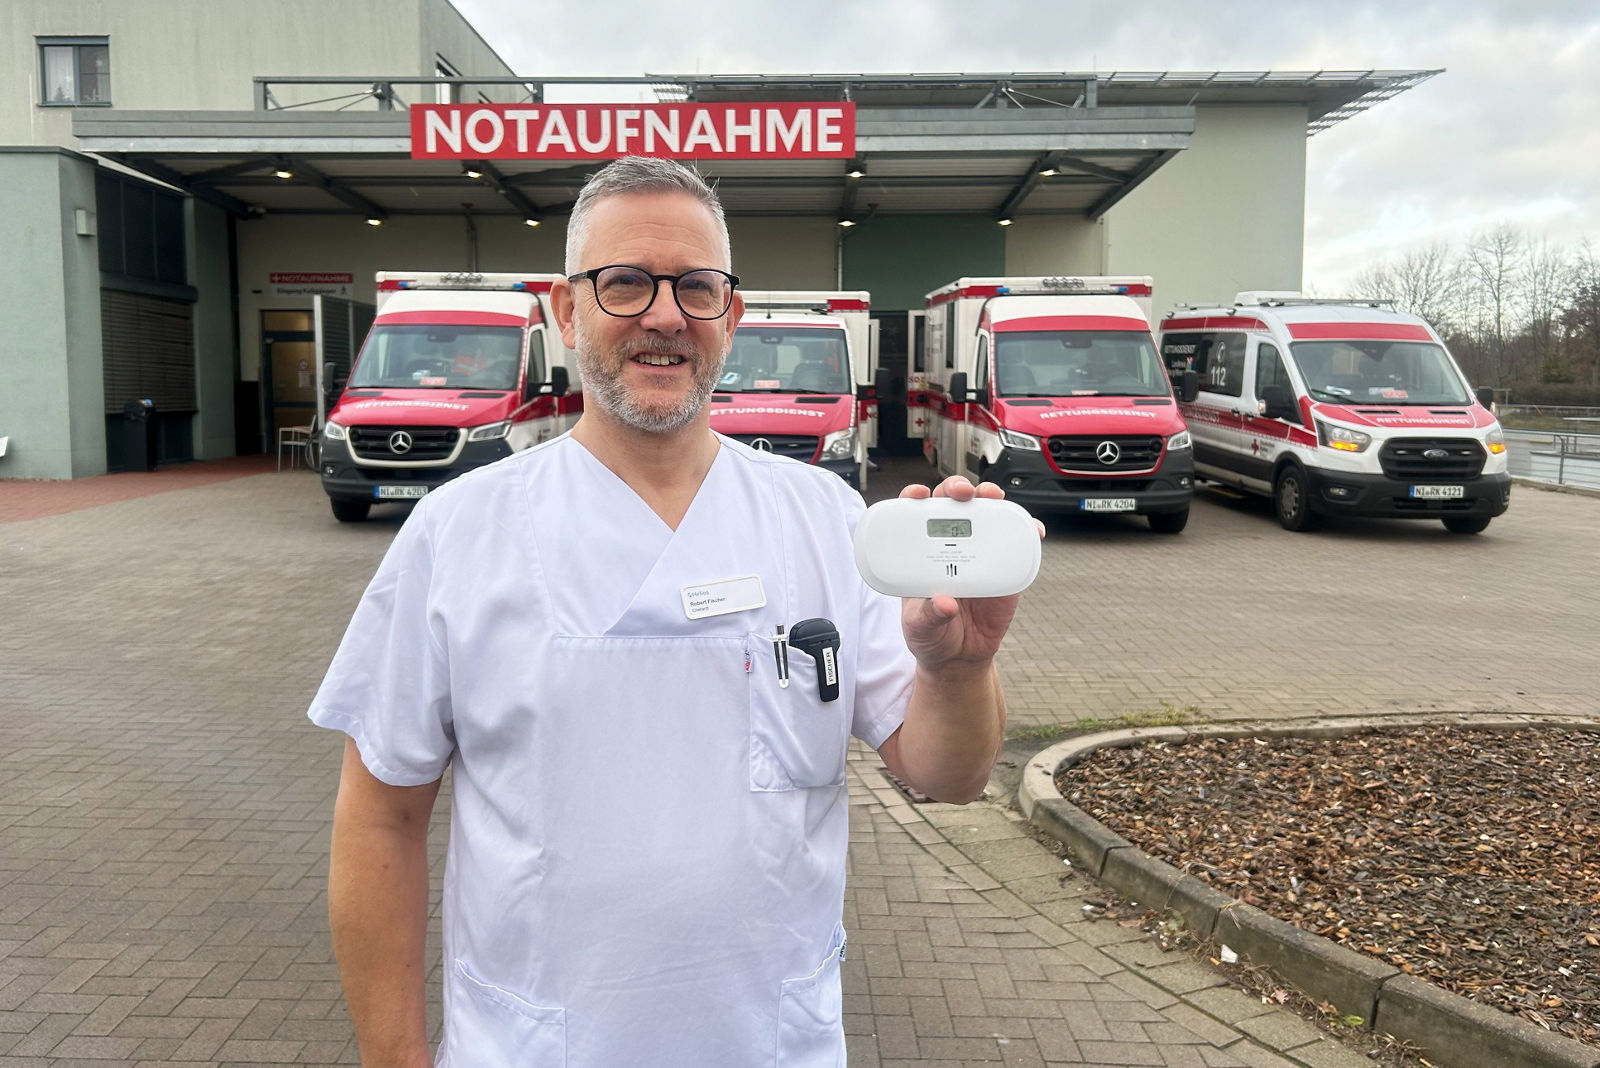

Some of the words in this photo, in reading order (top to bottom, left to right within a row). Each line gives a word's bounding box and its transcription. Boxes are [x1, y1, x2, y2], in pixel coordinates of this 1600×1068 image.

[425, 109, 844, 153] NOTAUFNAHME
[281, 274, 351, 282] NOTAUFNAHME
[1210, 366, 1227, 387] 112
[355, 400, 469, 411] RETTUNGSDIENST
[709, 407, 825, 418] ETTUNGSDIENST
[1039, 408, 1156, 419] RETTUNGSDIENST
[1376, 417, 1471, 425] RETTUNGSDIENST
[1416, 487, 1425, 496] NI
[1431, 487, 1441, 496] RK
[1442, 487, 1462, 496] 4121
[1086, 500, 1096, 509] NI
[1101, 500, 1112, 509] RK
[1114, 500, 1134, 509] 4204
[690, 599, 707, 607] Robert
[825, 651, 834, 682] FISCHER
